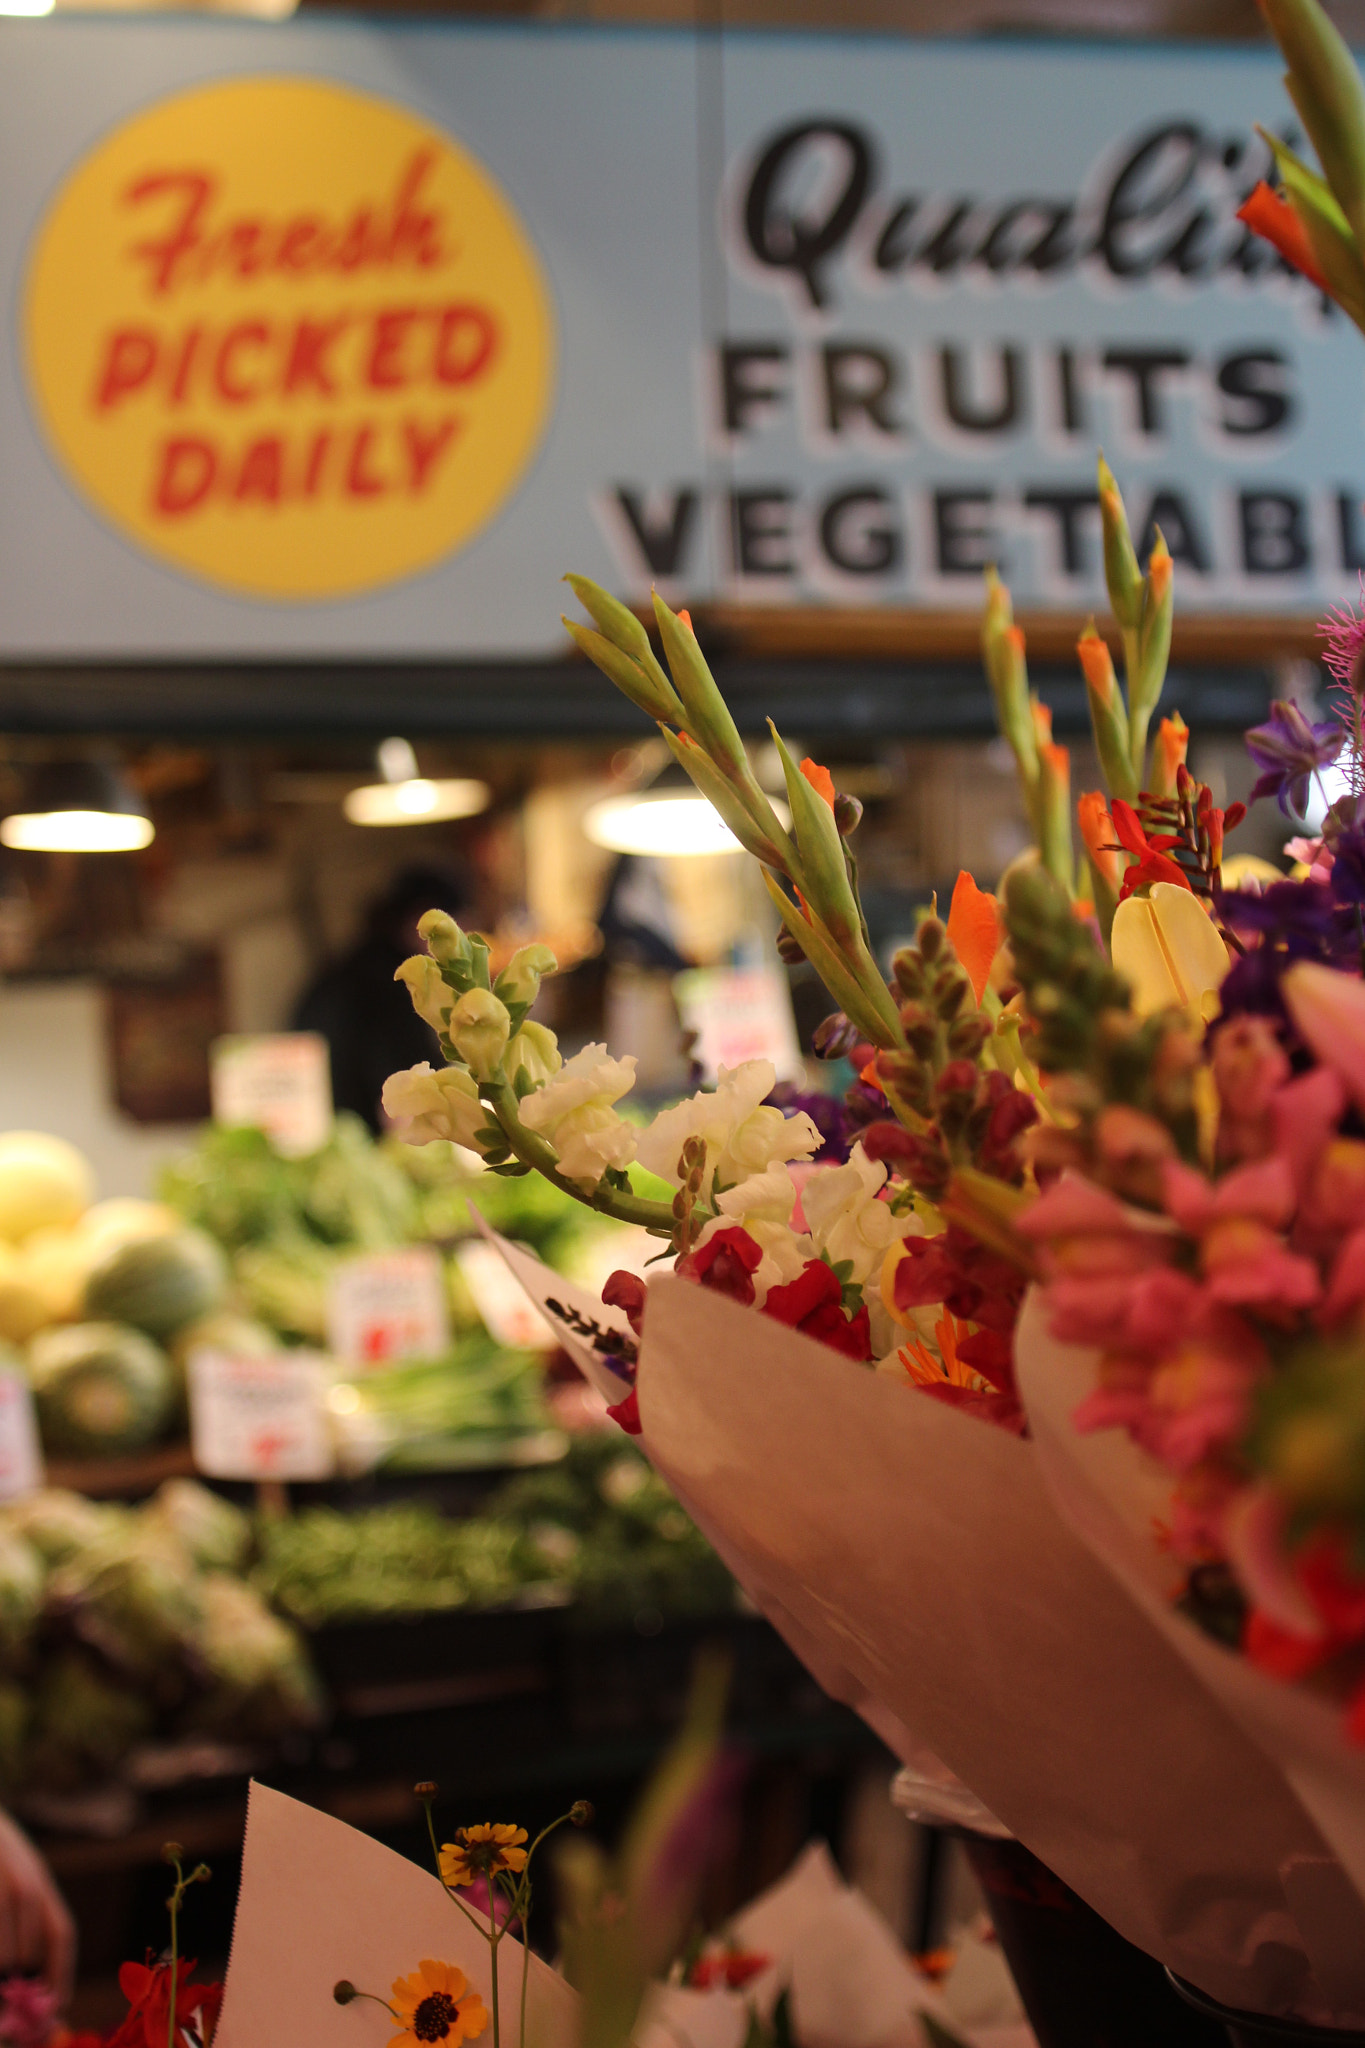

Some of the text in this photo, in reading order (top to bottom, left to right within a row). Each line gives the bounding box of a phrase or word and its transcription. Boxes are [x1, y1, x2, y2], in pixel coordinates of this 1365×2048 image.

[117, 140, 450, 300] Fresh
[741, 113, 1335, 316] Quali
[93, 303, 503, 418] PICKED
[716, 340, 1298, 437] FRUITS
[152, 410, 460, 525] DAILY
